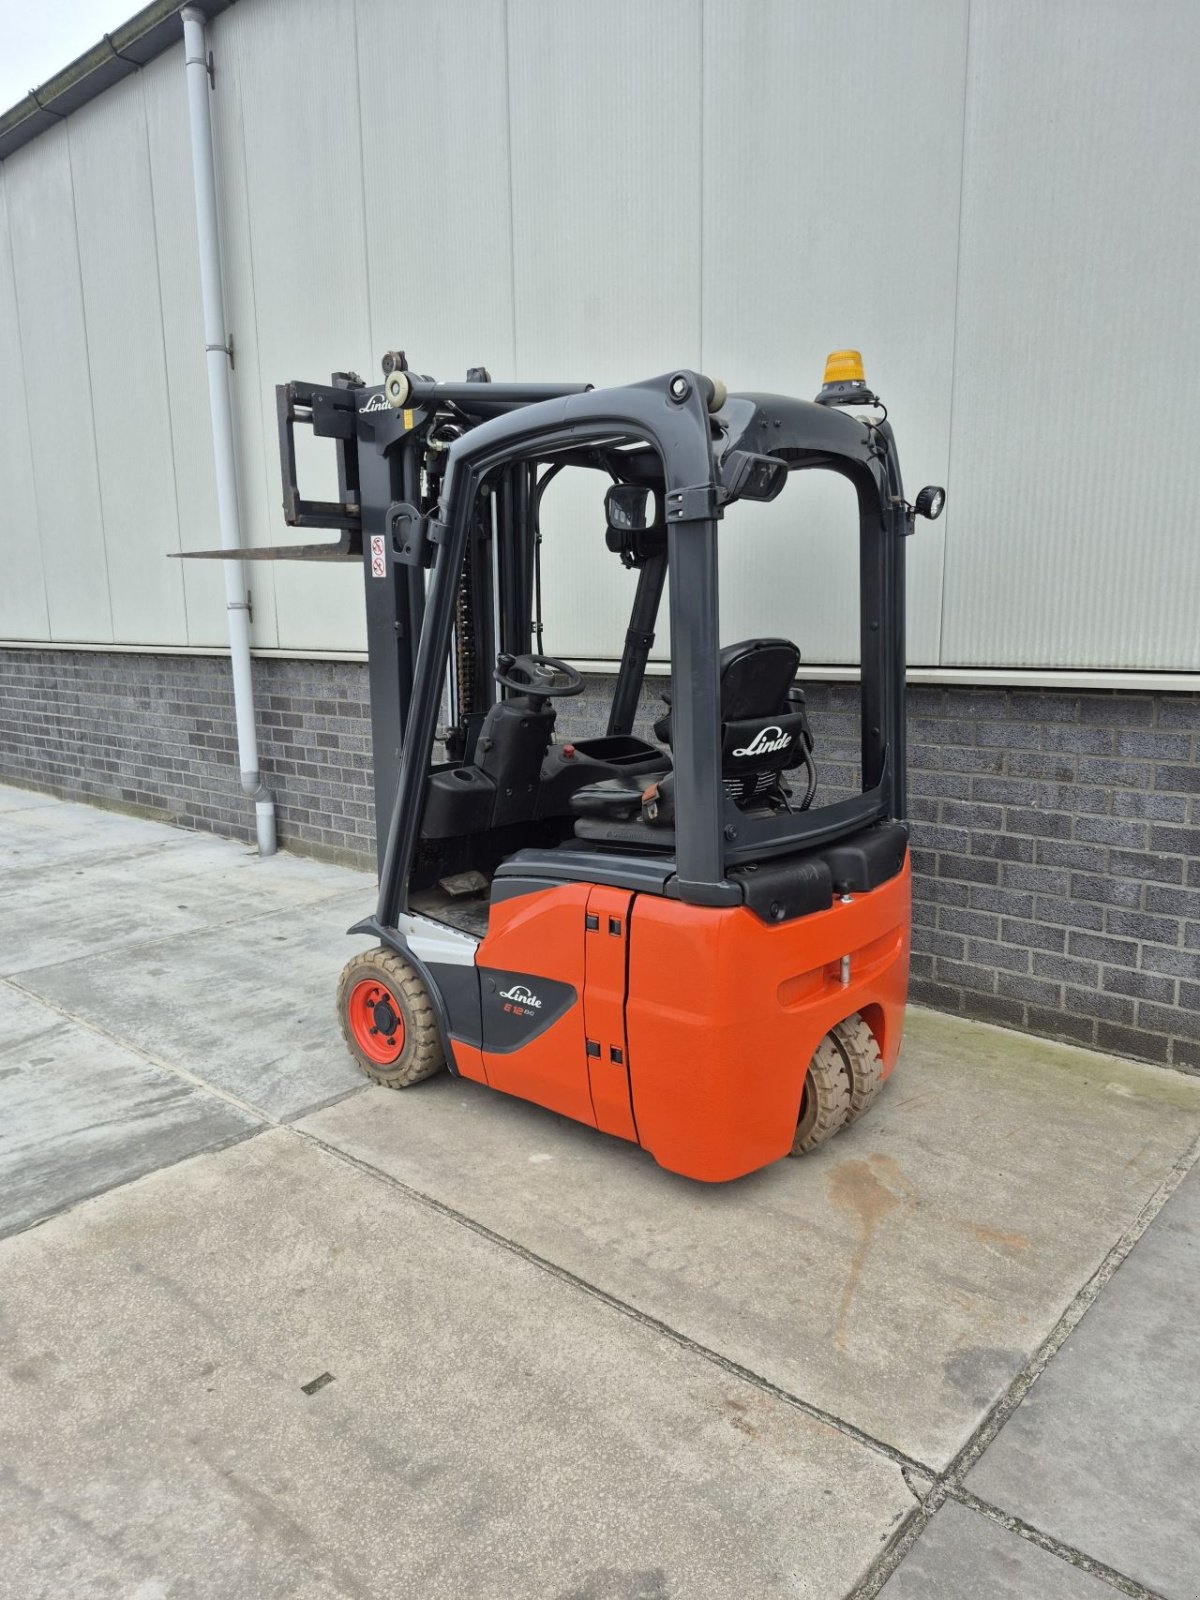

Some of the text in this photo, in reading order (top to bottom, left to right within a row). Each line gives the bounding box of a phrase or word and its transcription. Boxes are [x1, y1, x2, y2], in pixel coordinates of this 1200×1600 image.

[732, 726, 792, 757] Linde
[499, 985, 542, 1008] Linde
[503, 1003, 513, 1013] E
